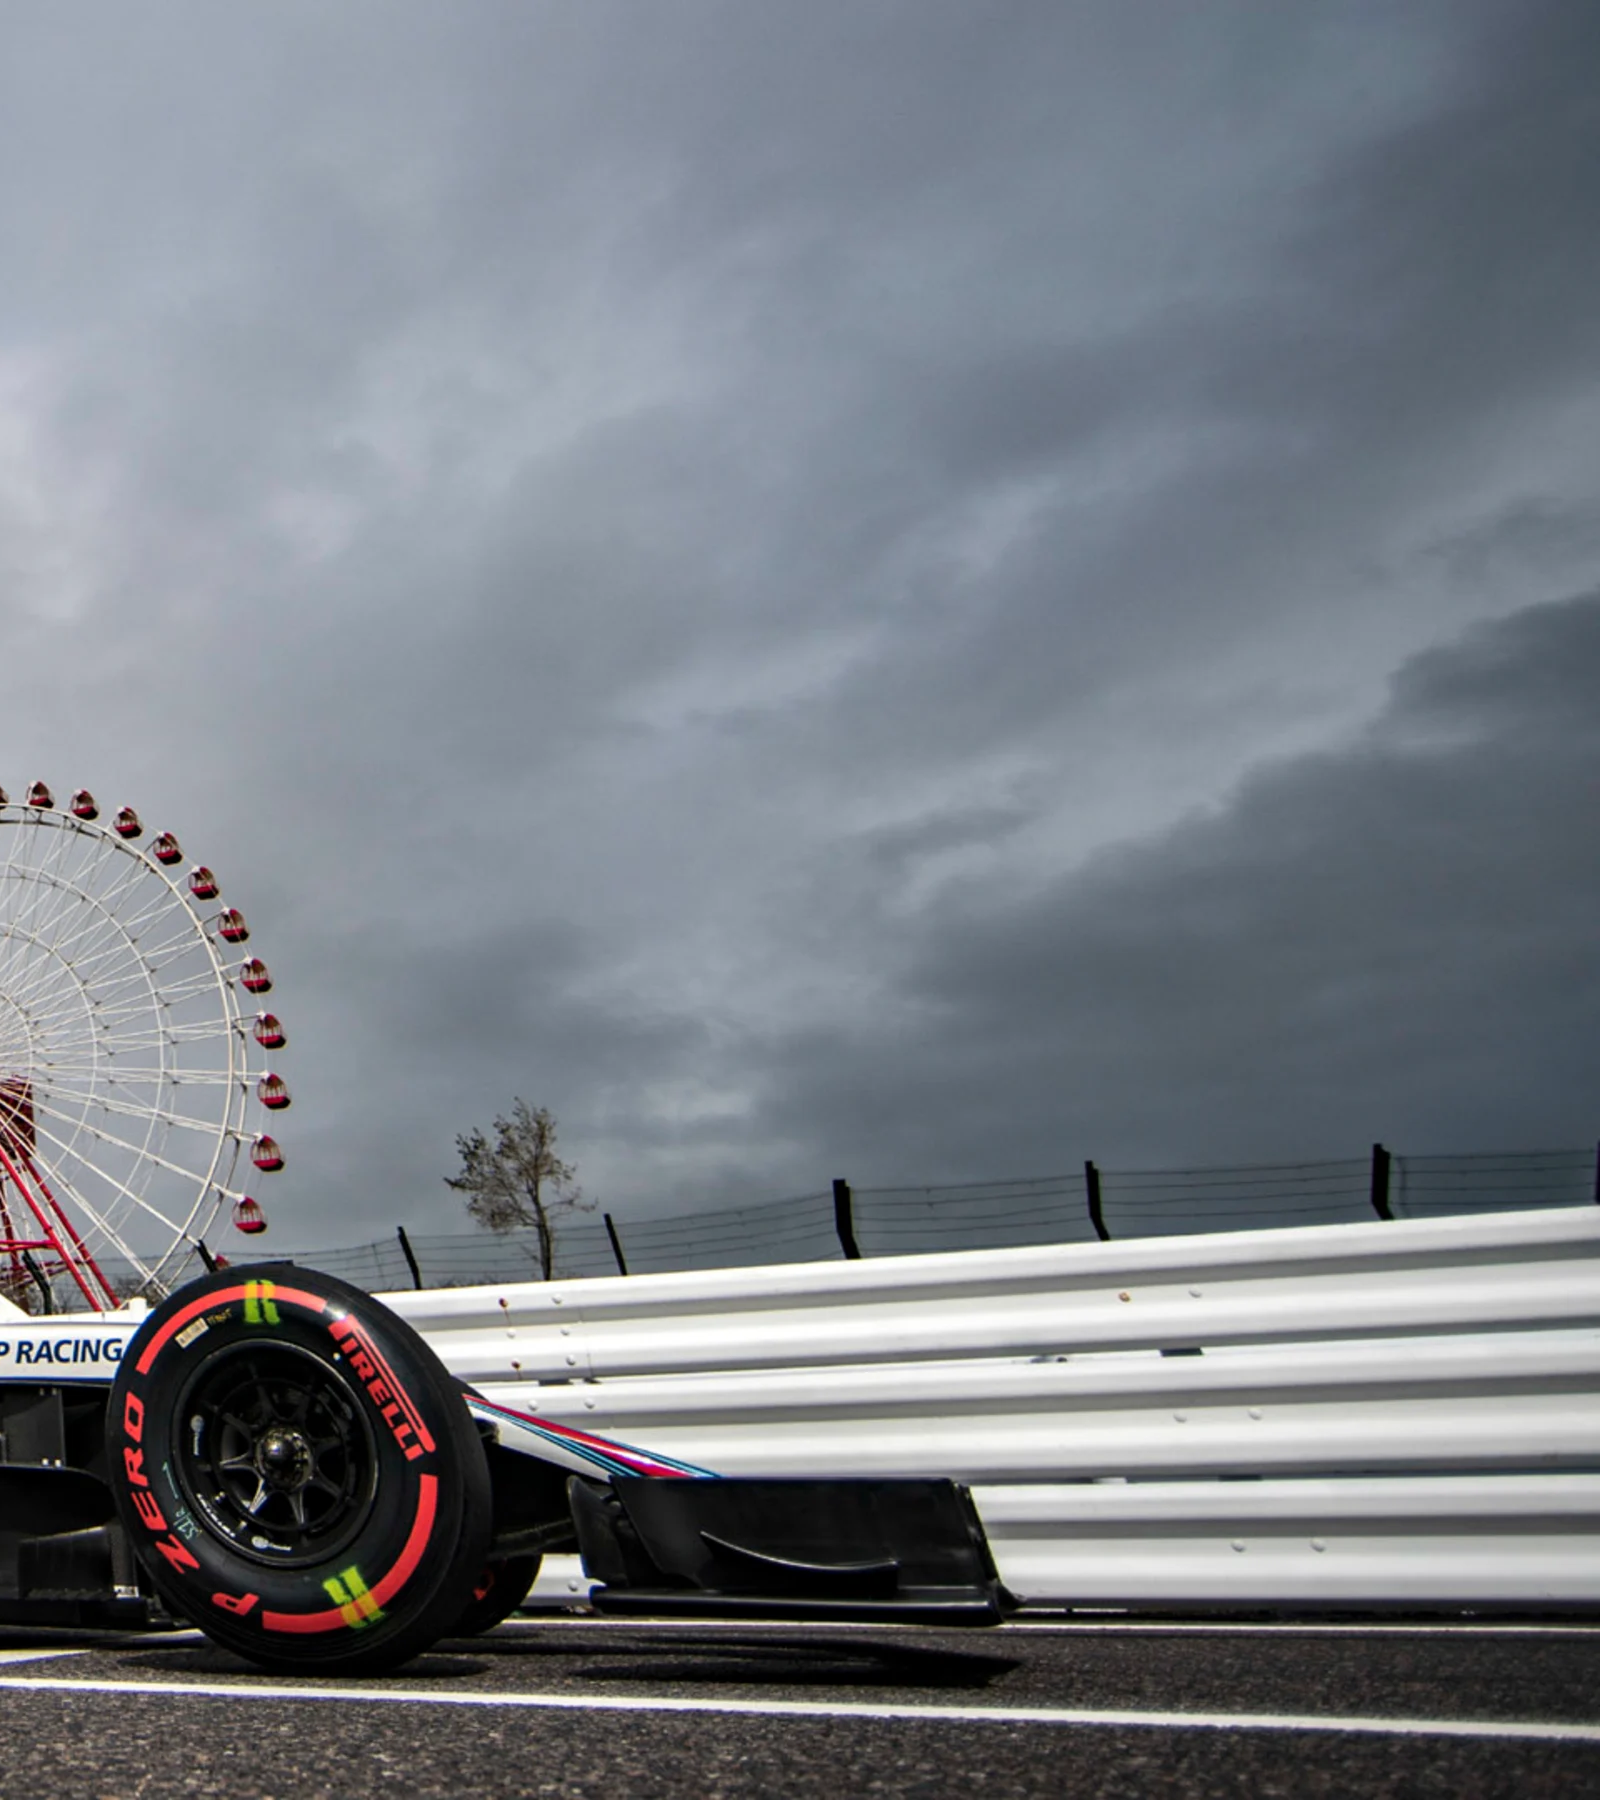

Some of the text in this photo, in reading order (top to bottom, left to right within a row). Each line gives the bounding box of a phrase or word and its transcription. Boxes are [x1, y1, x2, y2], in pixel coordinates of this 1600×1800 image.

[14, 1338, 124, 1364] RACING
[329, 1314, 436, 1462] PIRELLI
[123, 1391, 200, 1575] ZERO
[211, 1592, 260, 1616] P
